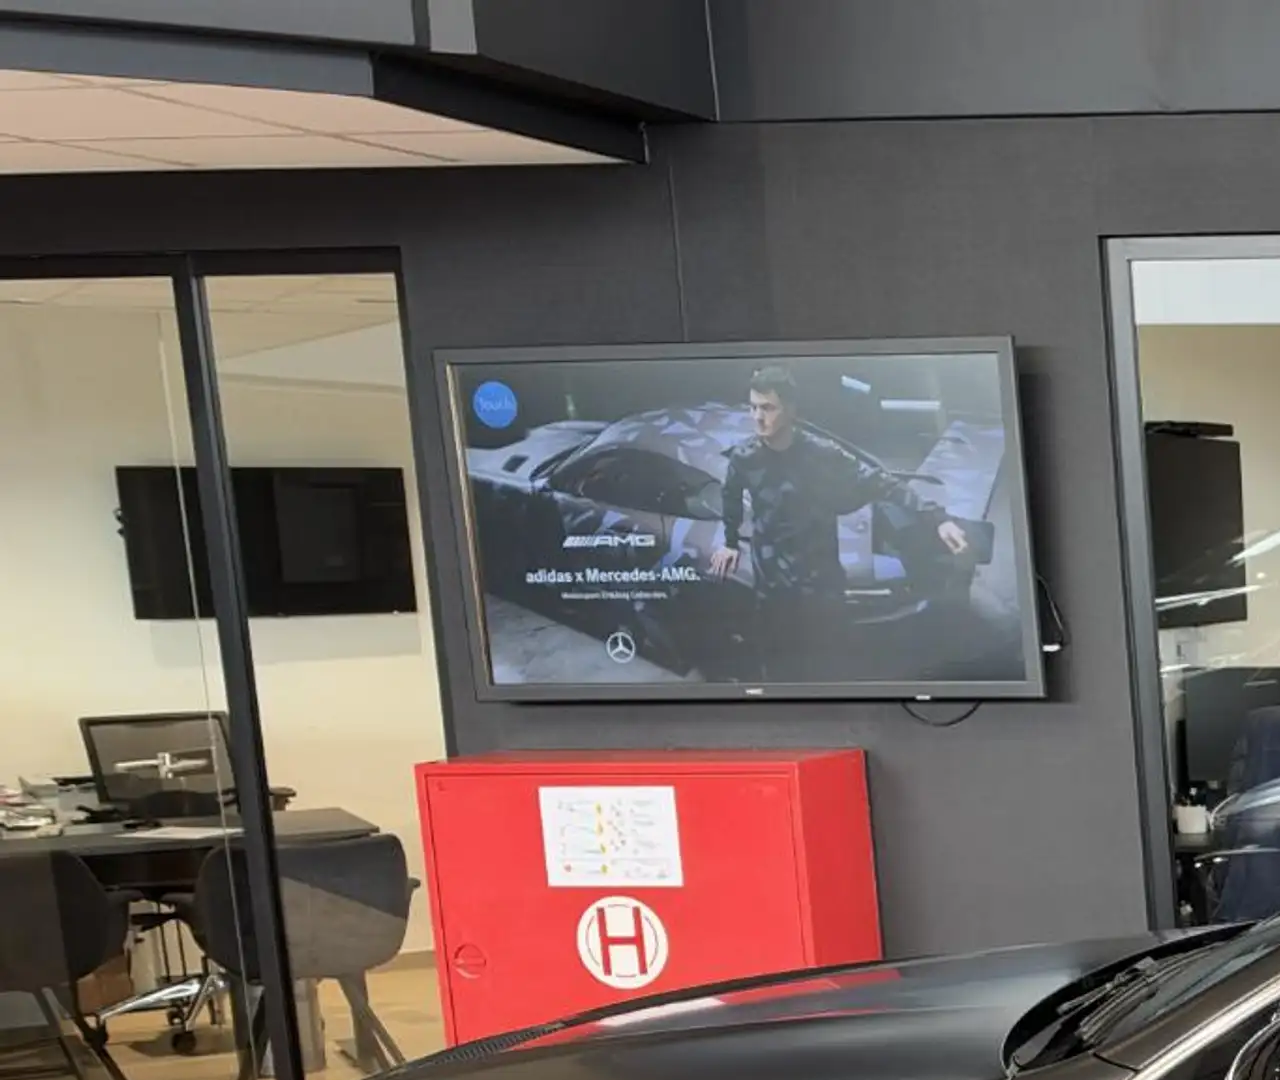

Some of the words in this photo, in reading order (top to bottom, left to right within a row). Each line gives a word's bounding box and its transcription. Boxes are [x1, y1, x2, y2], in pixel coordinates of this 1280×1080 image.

[525, 568, 573, 583] adidas
[575, 571, 584, 582] x
[585, 565, 701, 583] Mercedes-AMG.
[595, 905, 648, 976] H
